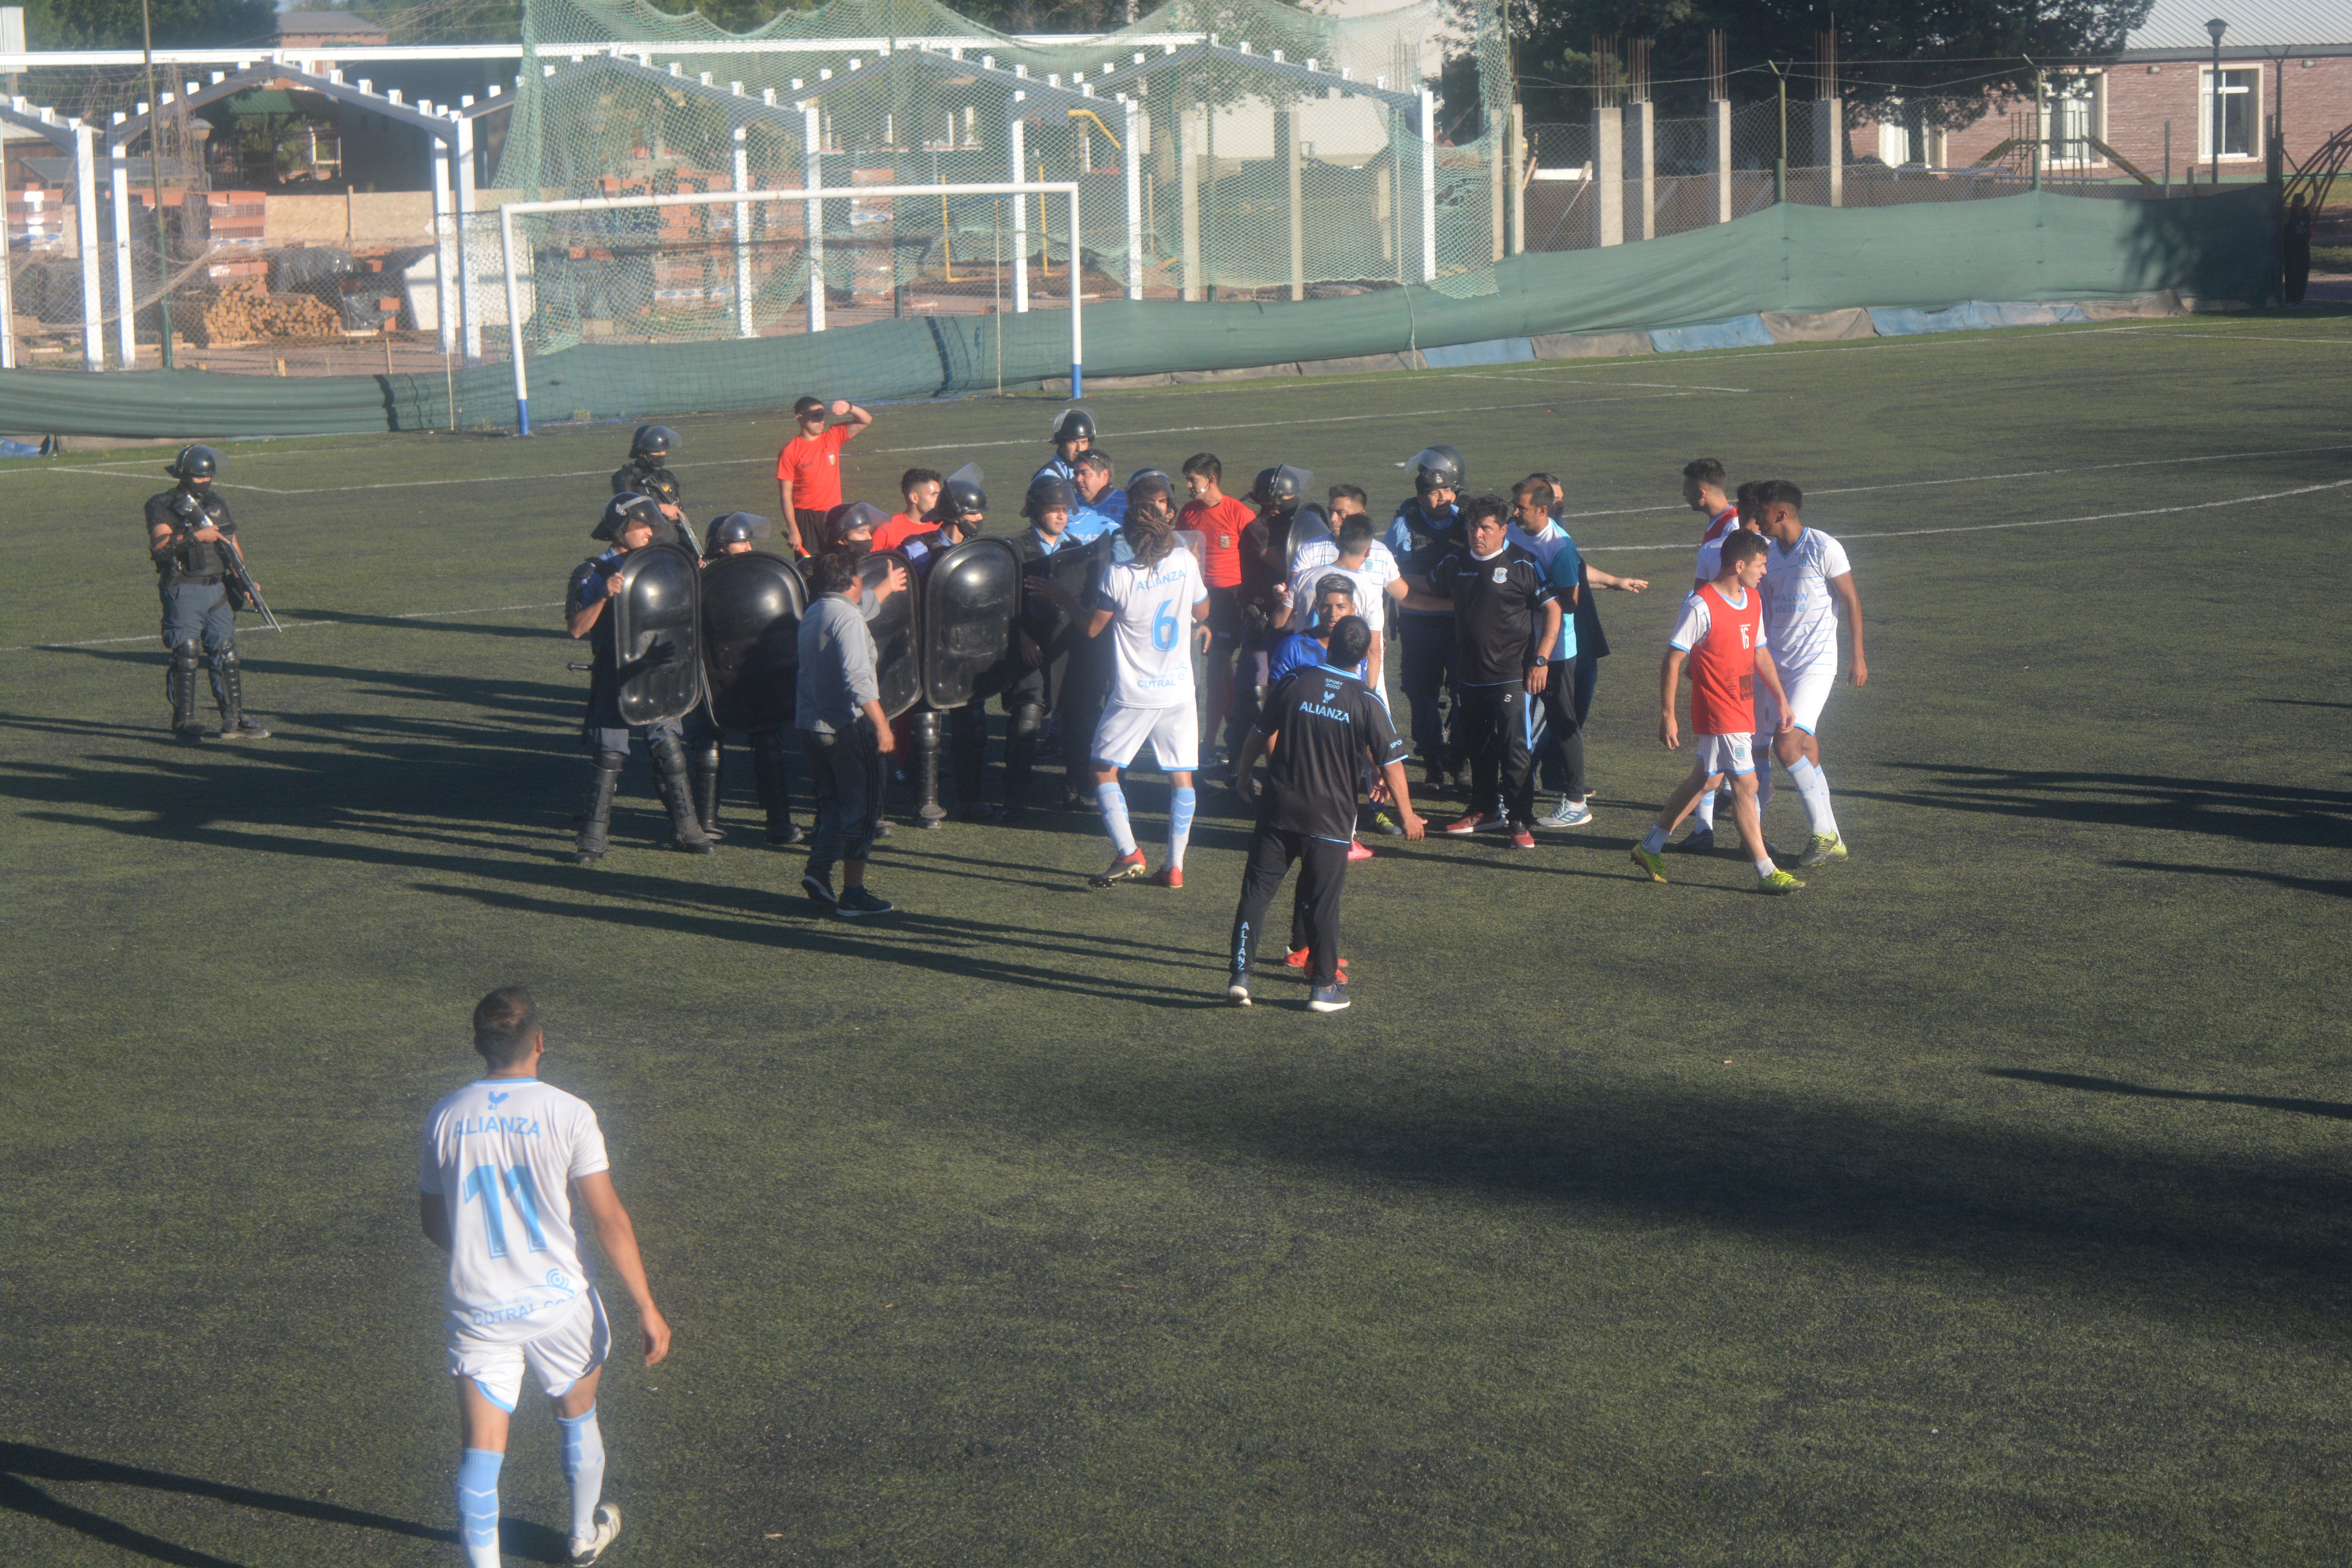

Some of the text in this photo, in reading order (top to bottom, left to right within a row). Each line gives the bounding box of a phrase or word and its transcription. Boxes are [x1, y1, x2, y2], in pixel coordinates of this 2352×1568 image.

[1136, 569, 1186, 591] ALIANZA
[1151, 599, 1180, 652] 6
[1740, 627, 1749, 650] 16
[1138, 679, 1176, 688] CUTRAL
[1299, 701, 1349, 723] ALIANZA
[1238, 921, 1249, 970] ALIANZ
[453, 1116, 541, 1139] ALIANZA
[463, 1164, 547, 1259] 11
